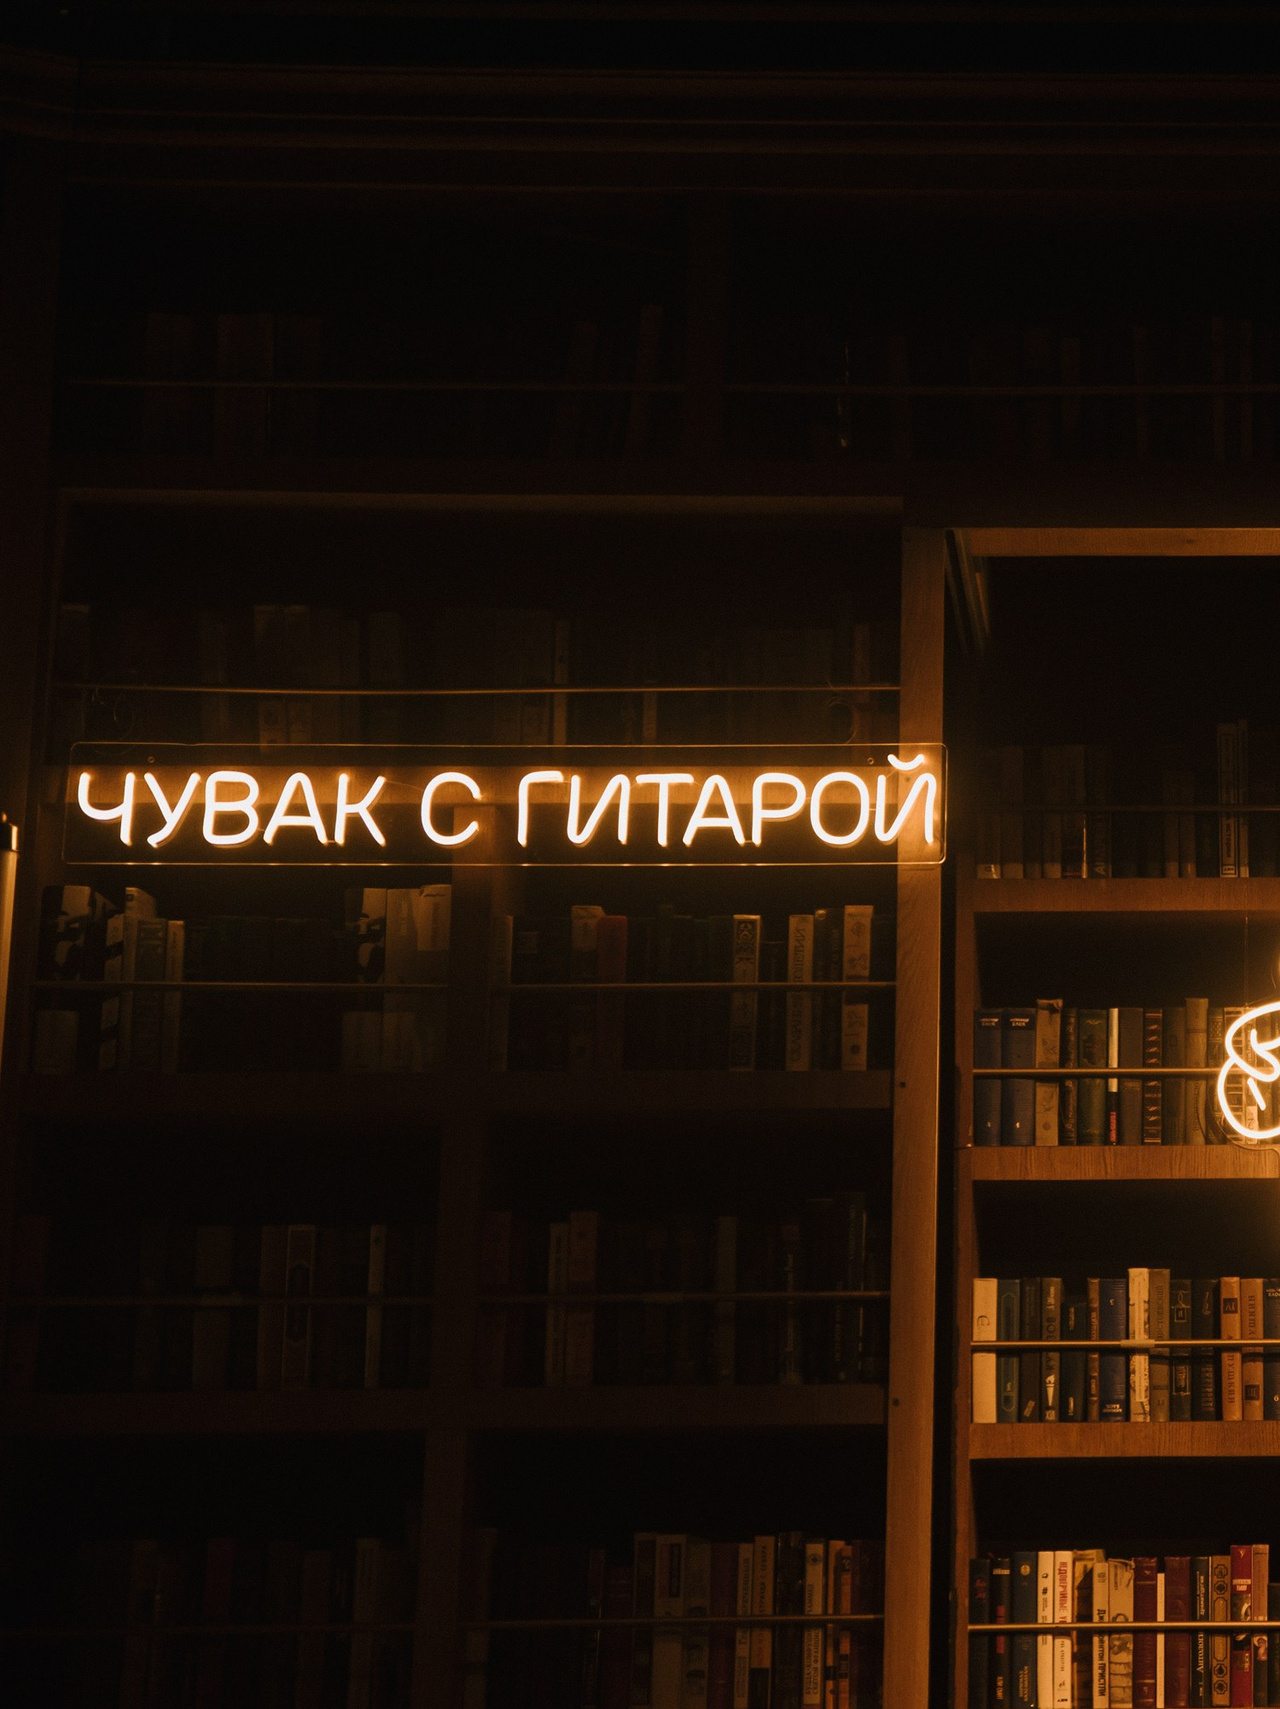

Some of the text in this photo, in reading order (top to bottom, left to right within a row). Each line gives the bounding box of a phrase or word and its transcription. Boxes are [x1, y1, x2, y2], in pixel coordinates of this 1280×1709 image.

[78, 752, 937, 848] ЧУВАК С ГИТАРОЙ
[1247, 1295, 1257, 1343] УШКИН
[1226, 1354, 1236, 1404] ПУШКИН
[1058, 1561, 1068, 1612] НЕДОВЕРЧИВЫЕ
[1097, 1632, 1106, 1661] ойнтон
[1195, 1630, 1205, 1674] Антологи
[1097, 1662, 1106, 1698] ПРИСТЛИ
